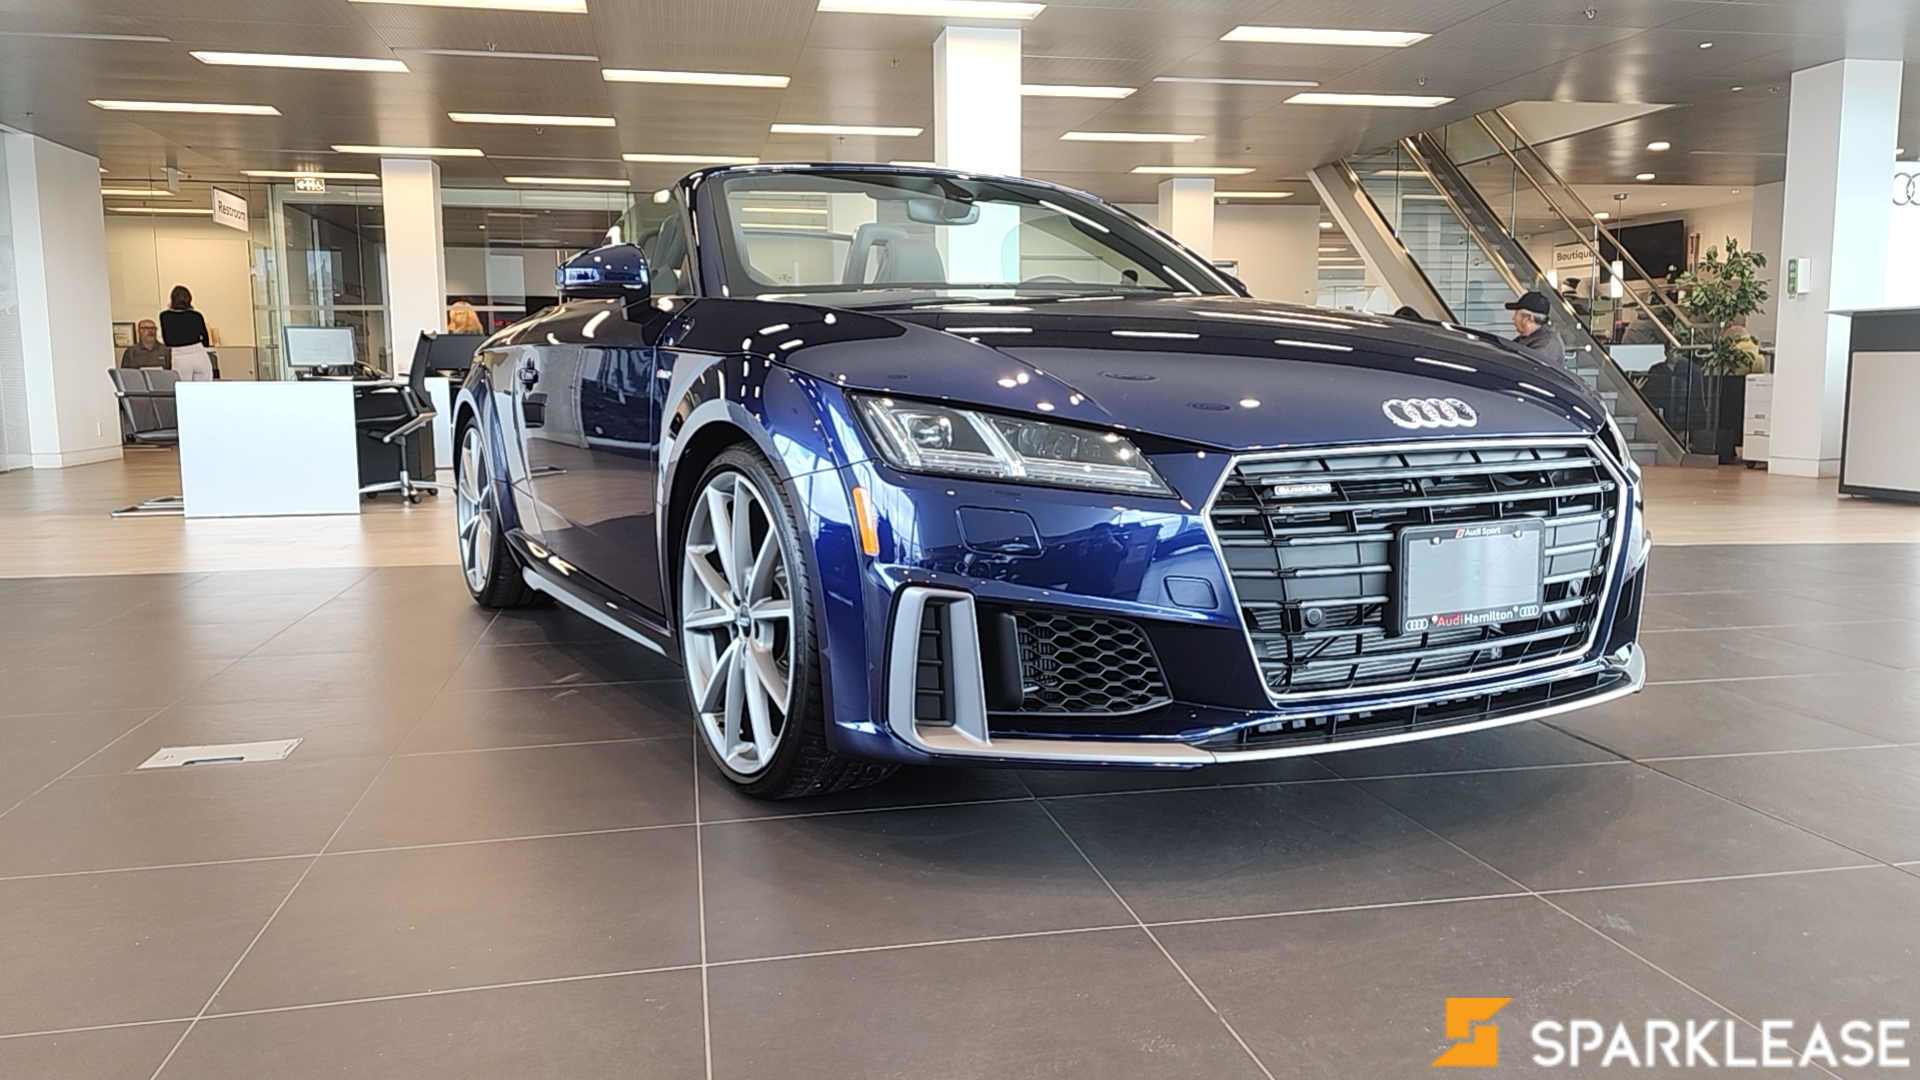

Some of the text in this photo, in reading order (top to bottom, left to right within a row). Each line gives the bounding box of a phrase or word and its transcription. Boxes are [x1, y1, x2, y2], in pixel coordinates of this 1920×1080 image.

[218, 199, 246, 222] Restroom
[1465, 526, 1501, 537] Audi Sport
